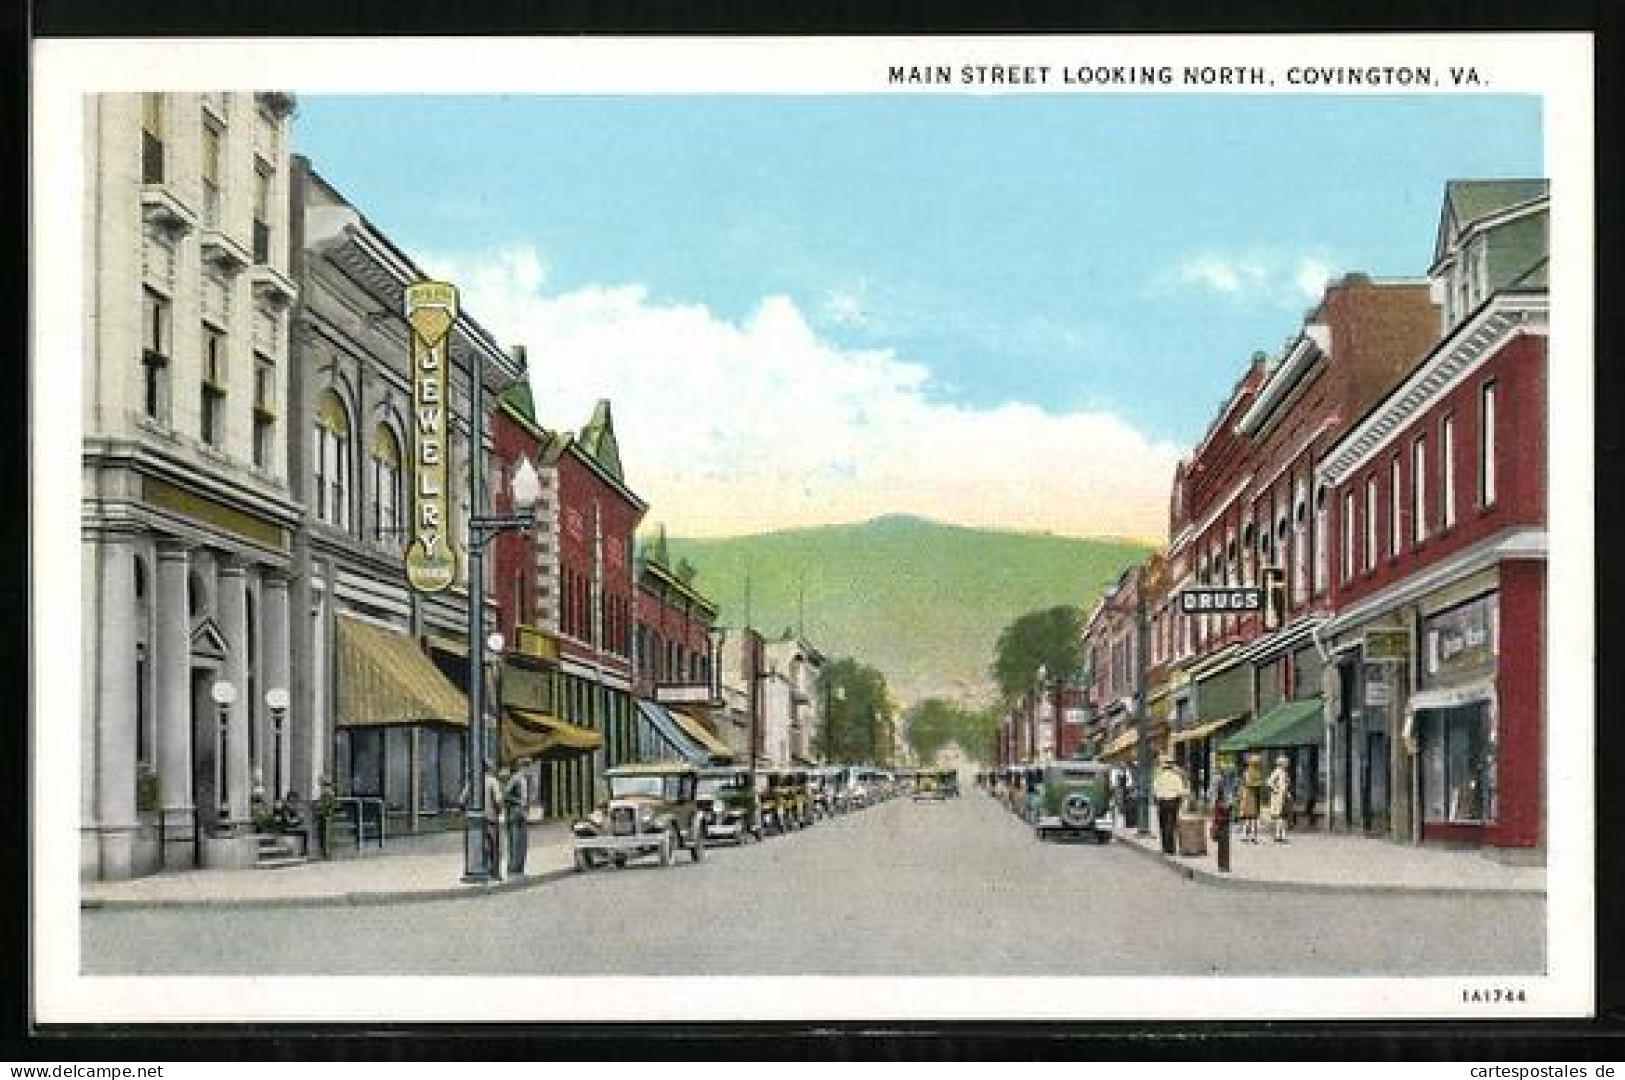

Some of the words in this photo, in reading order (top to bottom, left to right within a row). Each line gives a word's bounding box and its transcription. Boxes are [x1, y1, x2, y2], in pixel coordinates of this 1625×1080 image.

[888, 66, 951, 84] MAIN
[961, 66, 1050, 84] STREET
[1063, 66, 1172, 85] LOOKING
[1184, 66, 1275, 87] NORTH,
[1287, 66, 1440, 87] COVINGTON,
[1451, 66, 1490, 85] VA.
[420, 347, 439, 557] JEWELRY
[1184, 593, 1258, 609] DRUGS
